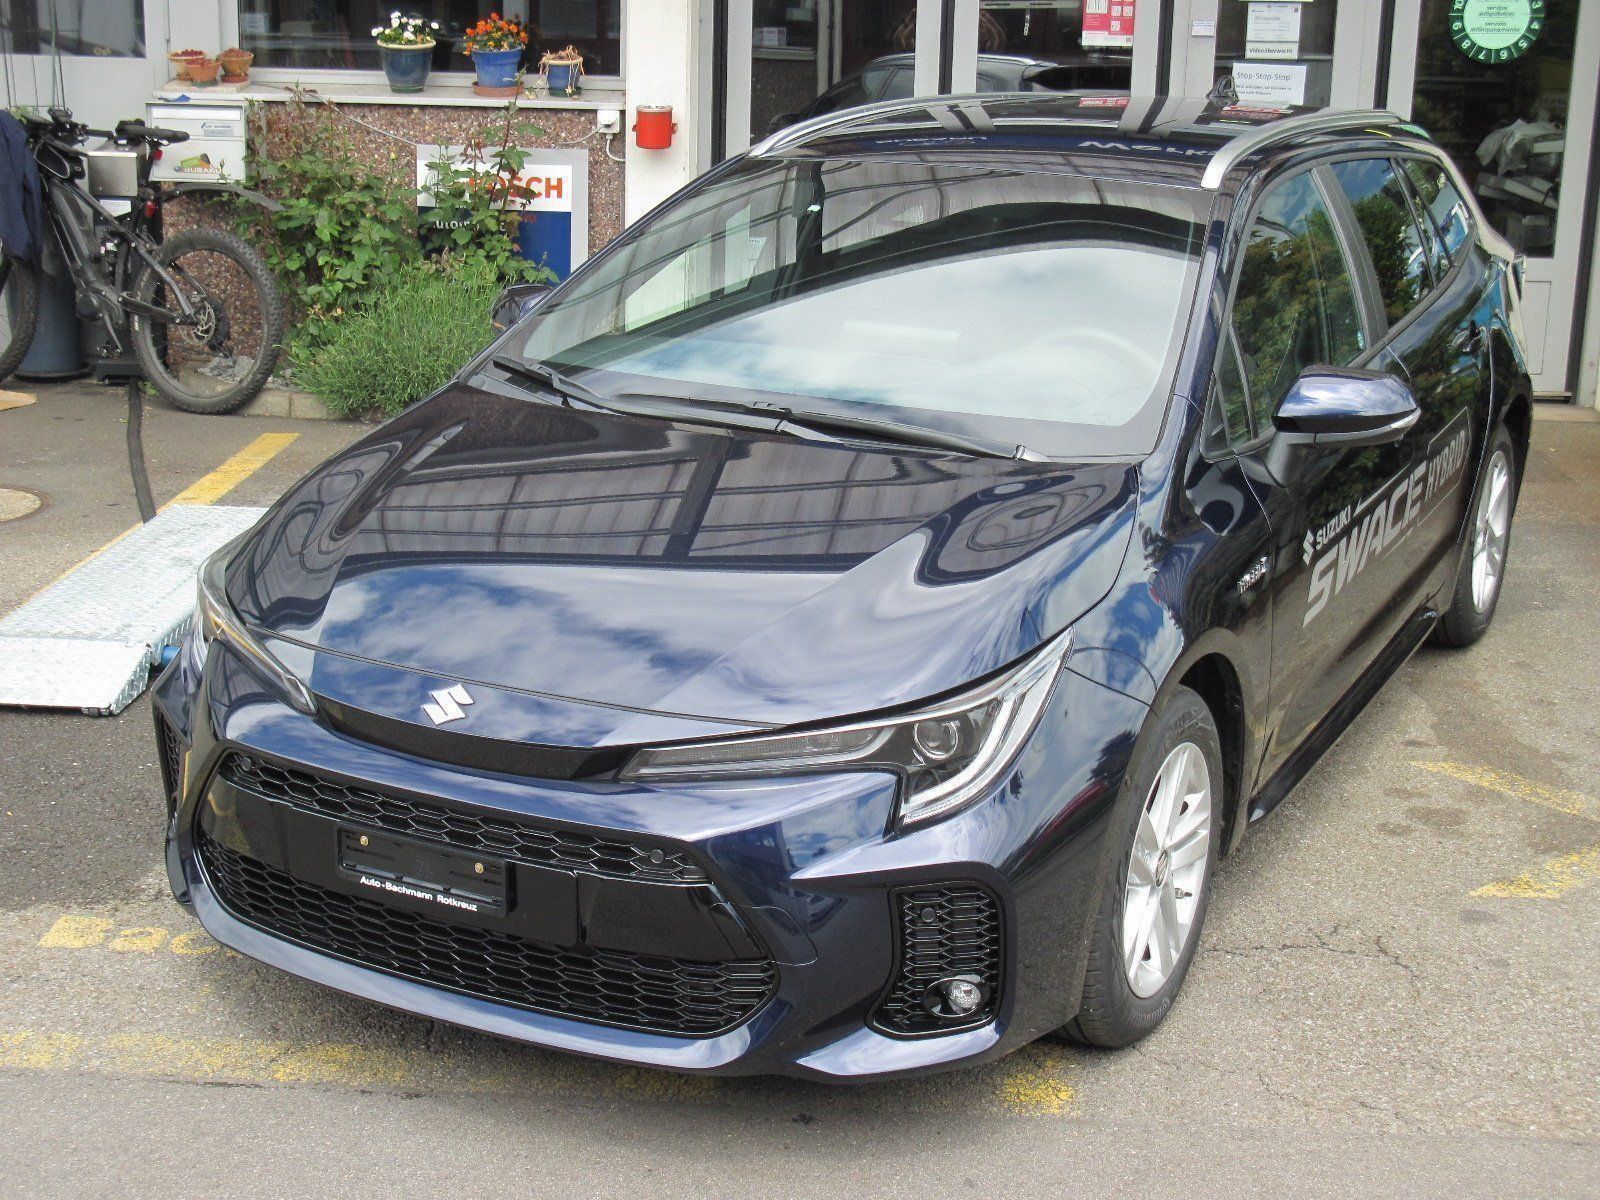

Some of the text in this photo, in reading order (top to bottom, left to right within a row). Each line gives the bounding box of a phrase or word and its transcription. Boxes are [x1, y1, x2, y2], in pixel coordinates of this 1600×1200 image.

[1236, 71, 1291, 83] Stop-Stop-Stop
[184, 166, 222, 174] SUBARU
[1316, 504, 1350, 551] SUZUKI
[1302, 459, 1427, 628] SWACE
[436, 894, 478, 912] Rotkreuz
